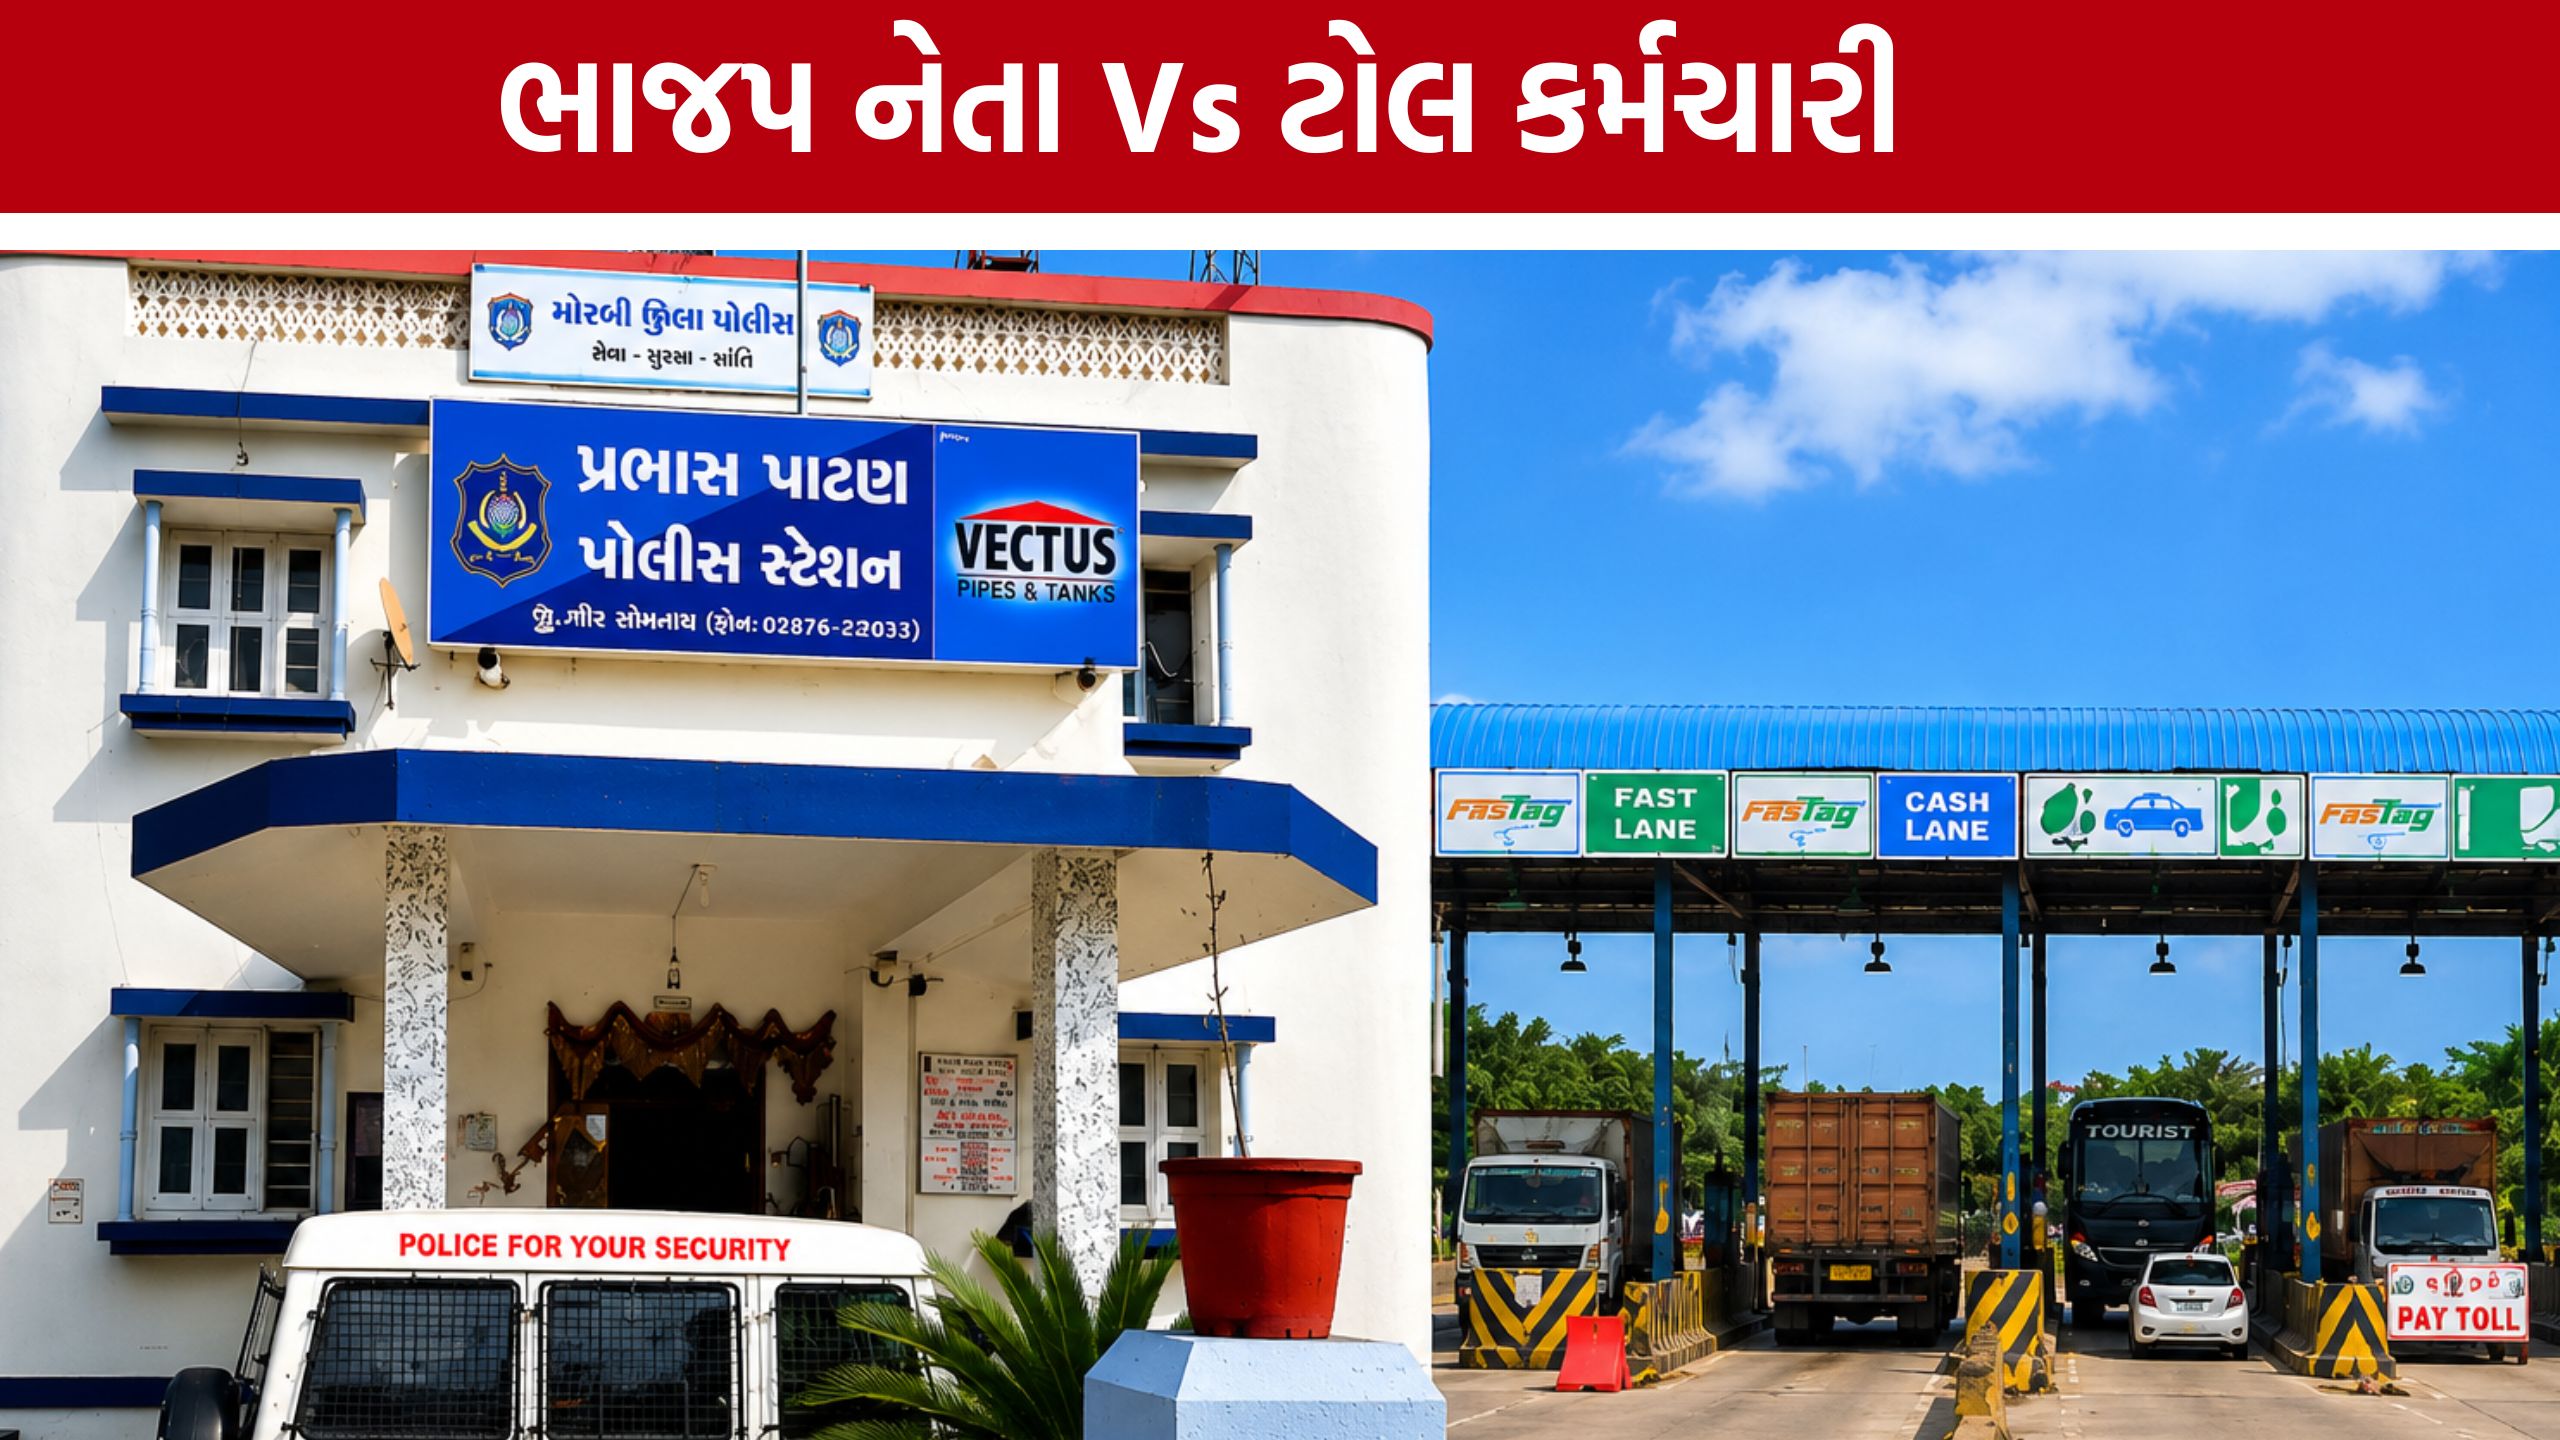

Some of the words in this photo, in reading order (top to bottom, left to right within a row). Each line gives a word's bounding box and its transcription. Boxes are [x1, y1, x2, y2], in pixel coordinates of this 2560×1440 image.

[552, 292, 631, 328] મોરબી
[712, 300, 794, 336] પોલીસ
[592, 340, 626, 362] સેવા
[577, 445, 739, 497] પ્રભાસ
[762, 454, 908, 505] પાટણ
[578, 519, 740, 584] પોલીસ
[760, 525, 901, 590] સ્ટેશન
[955, 523, 1116, 575] VECTUS
[958, 580, 1016, 600] PIPES
[1024, 582, 1037, 601] &
[1046, 583, 1115, 603] TANKS
[1615, 788, 1697, 808] FAST
[1905, 792, 1989, 812] CASH
[1615, 819, 1696, 839] LANE
[1906, 820, 1989, 841] LANE
[2085, 1124, 2196, 1139] TOURIST
[399, 1233, 498, 1258] POLICE
[508, 1234, 562, 1258] FOR
[570, 1235, 647, 1260] YOUR
[655, 1236, 791, 1262] SECURITY
[2398, 1306, 2449, 1331] PAY
[2456, 1307, 2520, 1331] TOLL
